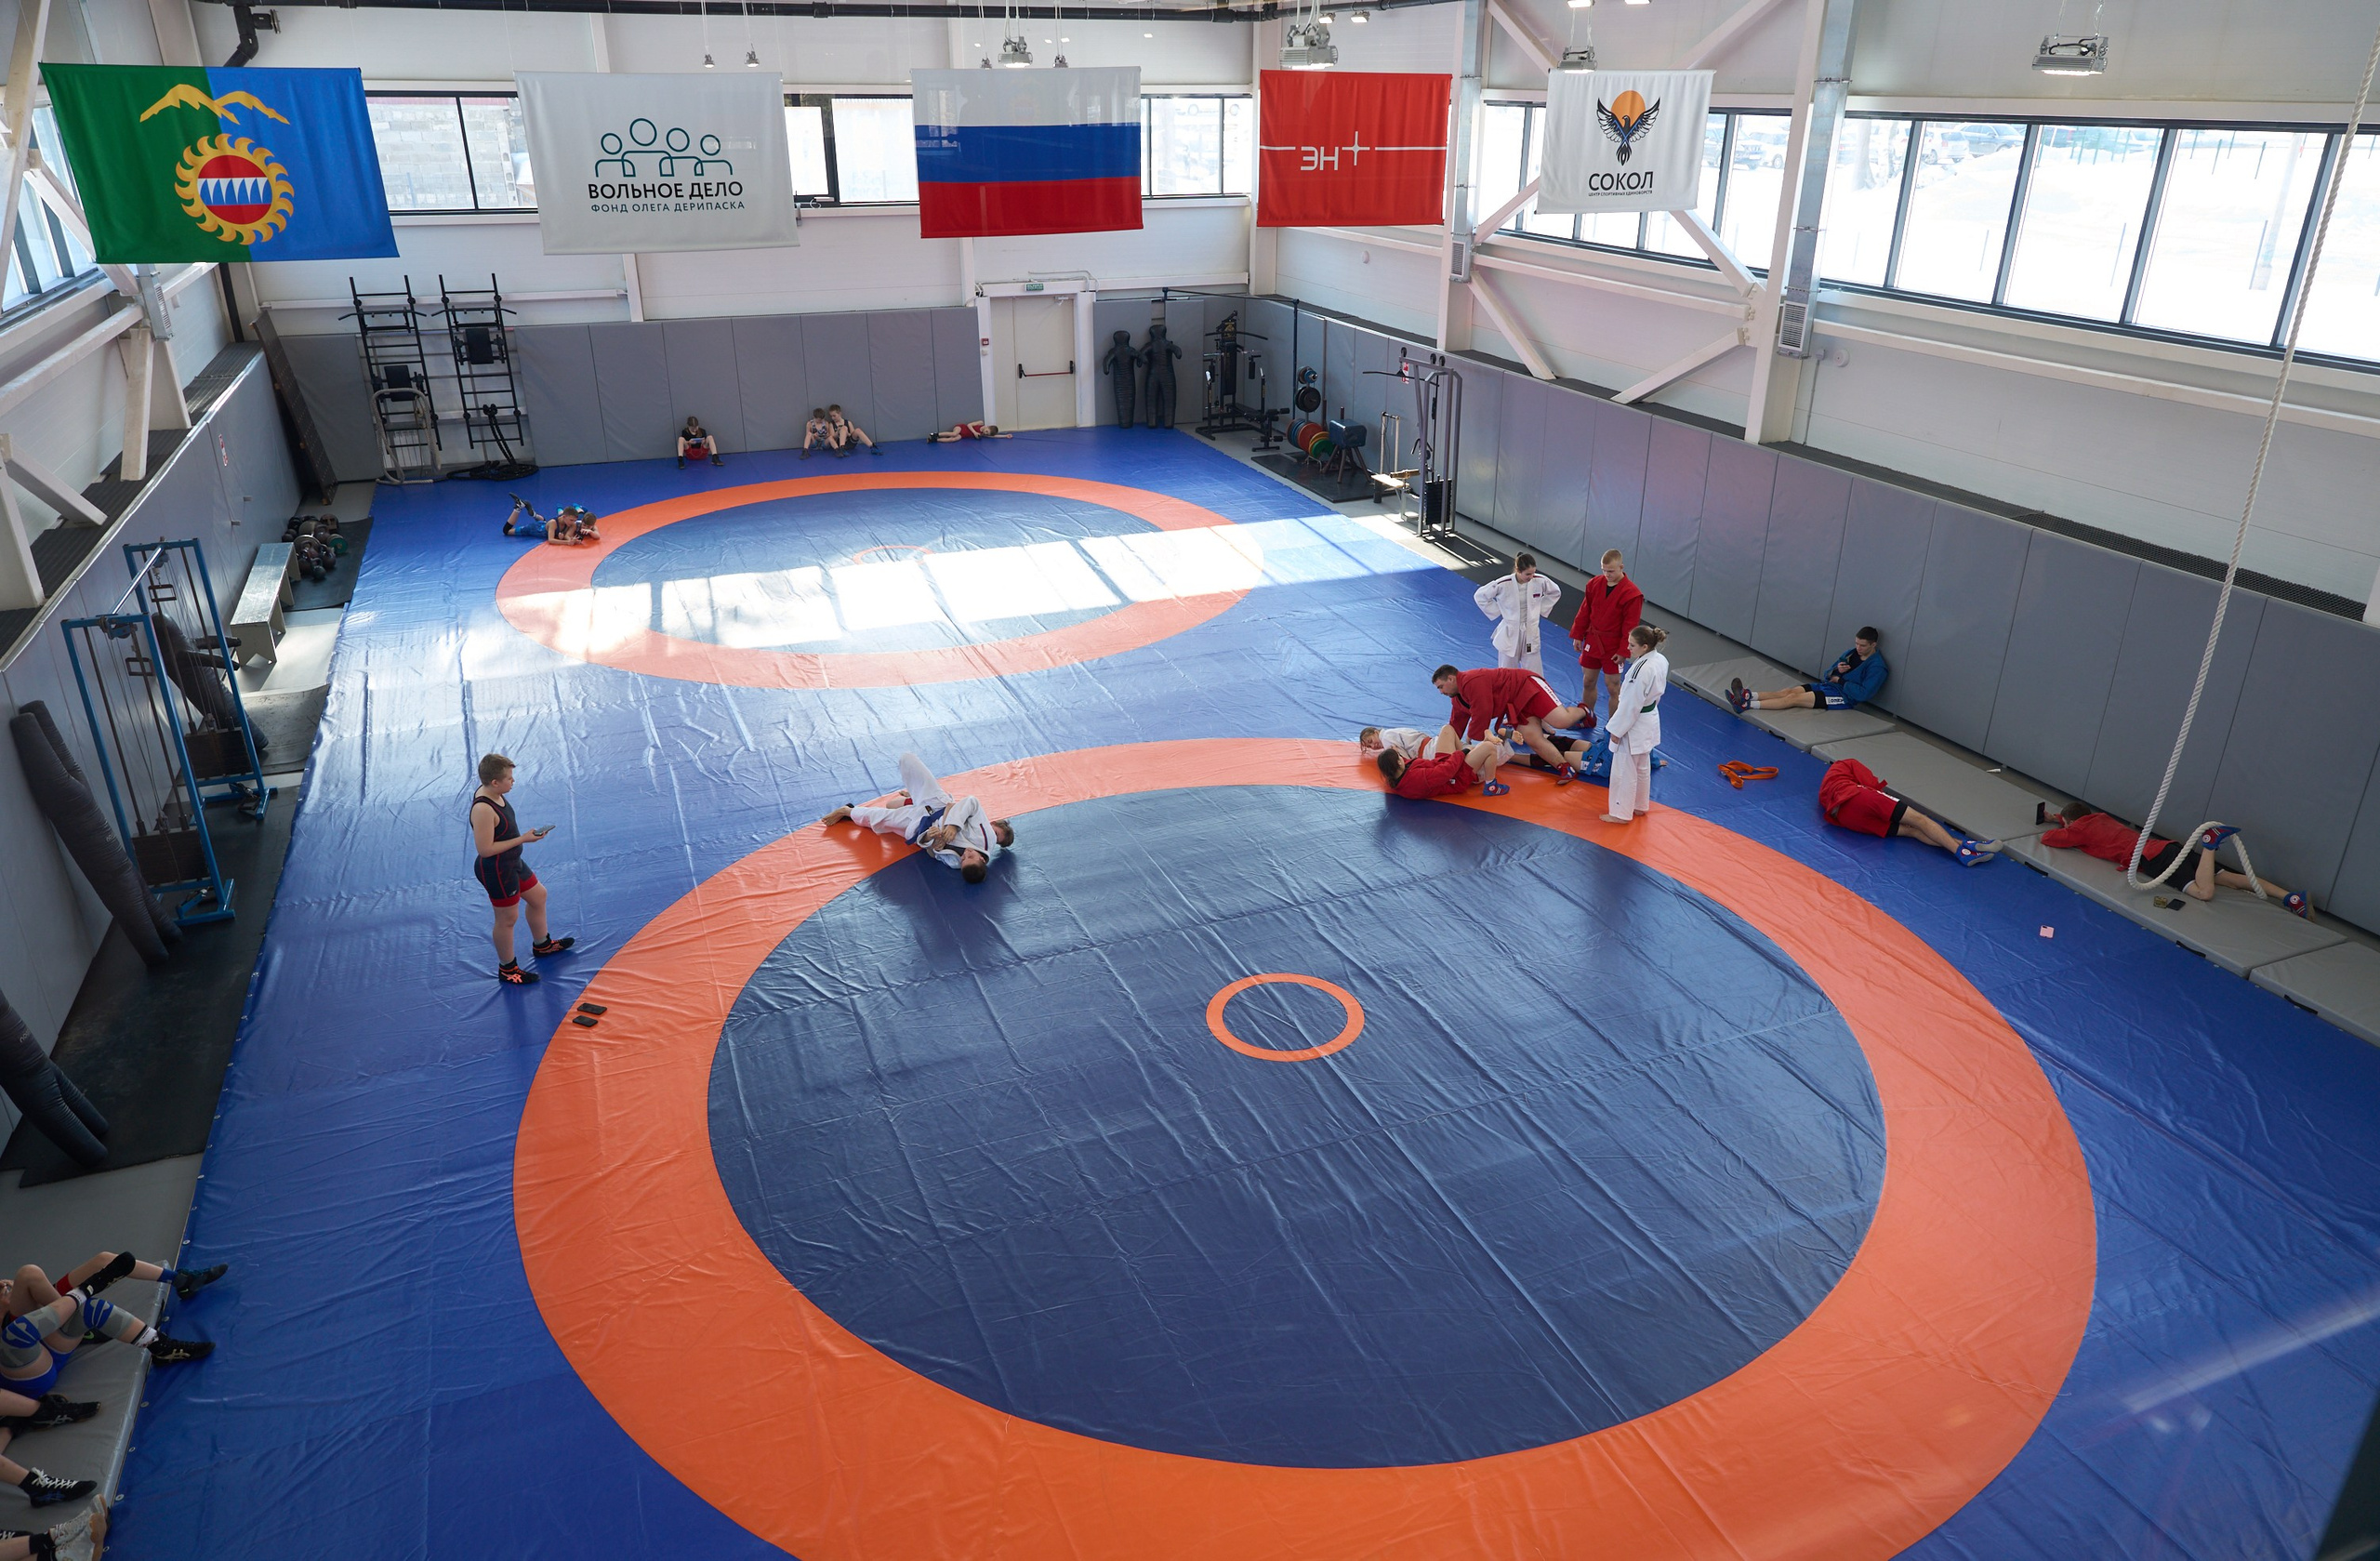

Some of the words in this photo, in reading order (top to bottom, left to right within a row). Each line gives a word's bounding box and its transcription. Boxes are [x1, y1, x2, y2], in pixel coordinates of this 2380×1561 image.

[588, 182, 684, 199] ВОЛЬНОЕ
[689, 181, 744, 200] ДЕЛО
[1589, 171, 1653, 191] СОКОЛ
[591, 204, 628, 214] ФОНД
[632, 203, 670, 213] ОЛЕГА
[674, 201, 746, 213] ДЕРИПАСКА
